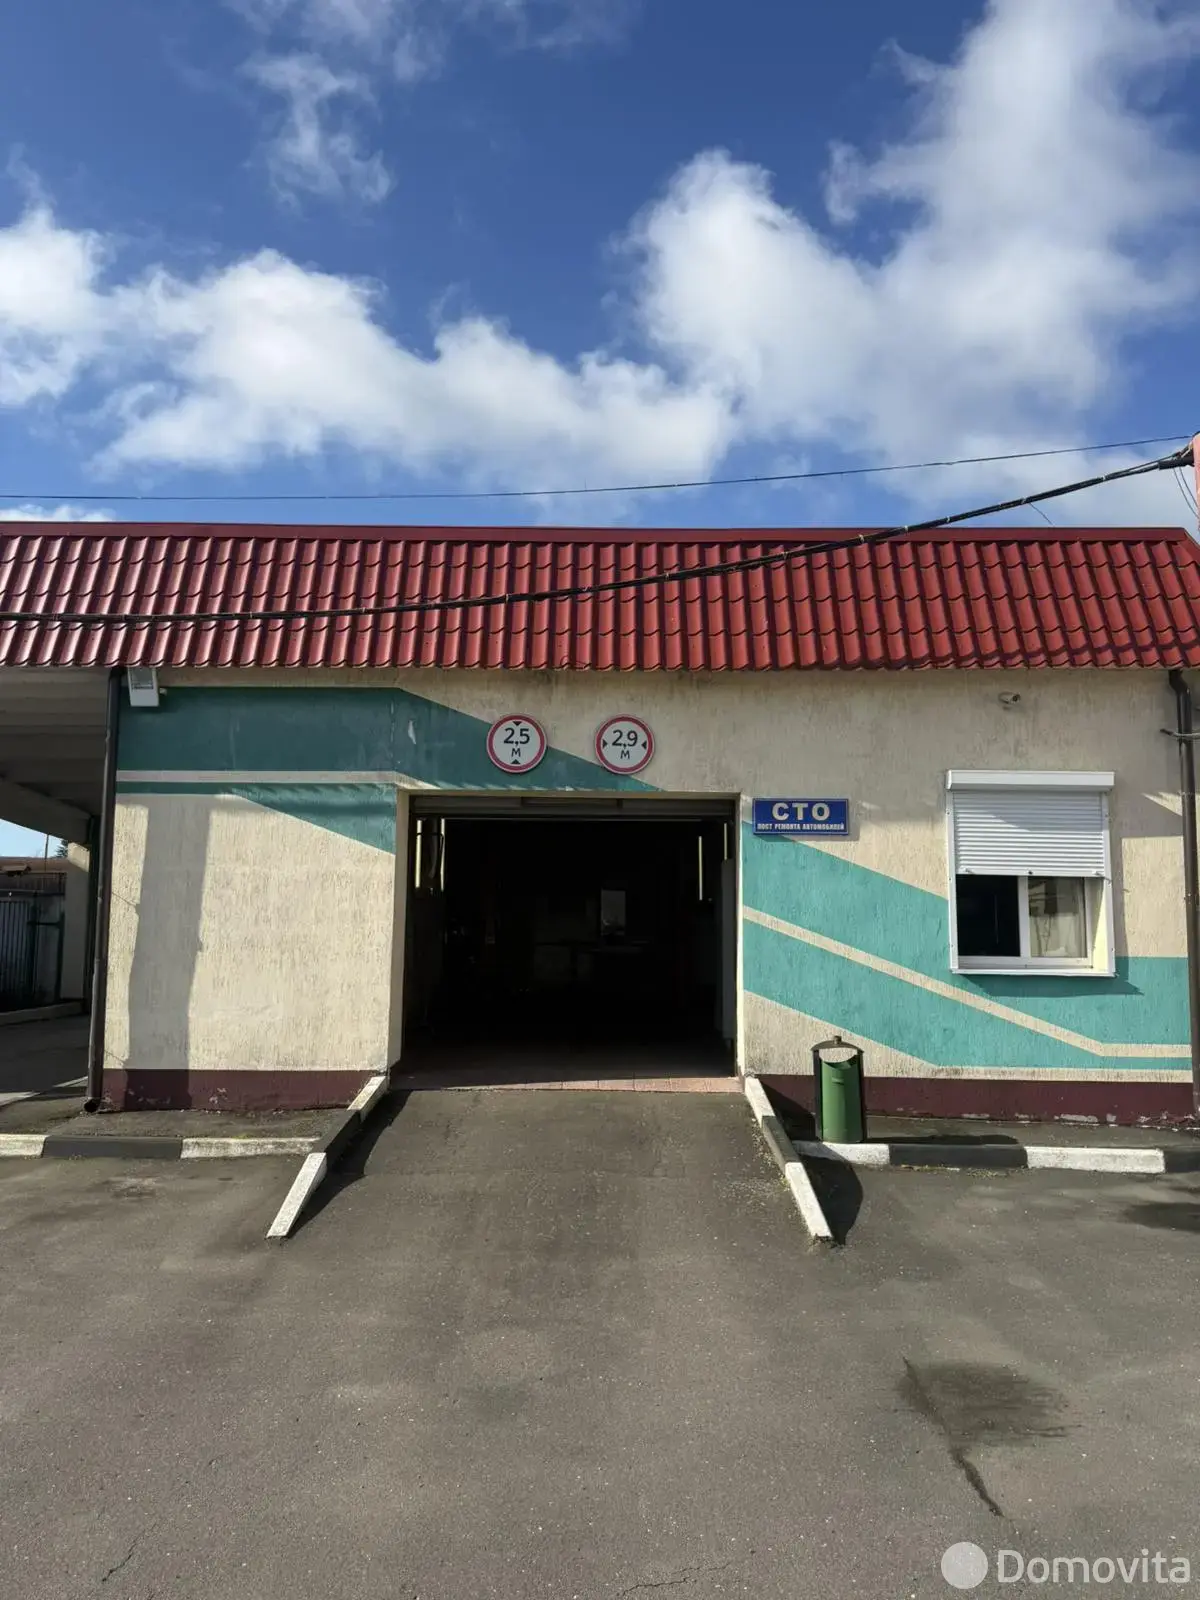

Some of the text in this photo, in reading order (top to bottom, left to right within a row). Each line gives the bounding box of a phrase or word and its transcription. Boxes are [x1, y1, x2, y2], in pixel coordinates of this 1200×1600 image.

[503, 727, 531, 746] 2,5
[611, 729, 639, 749] 2,9
[772, 802, 831, 821] СТО
